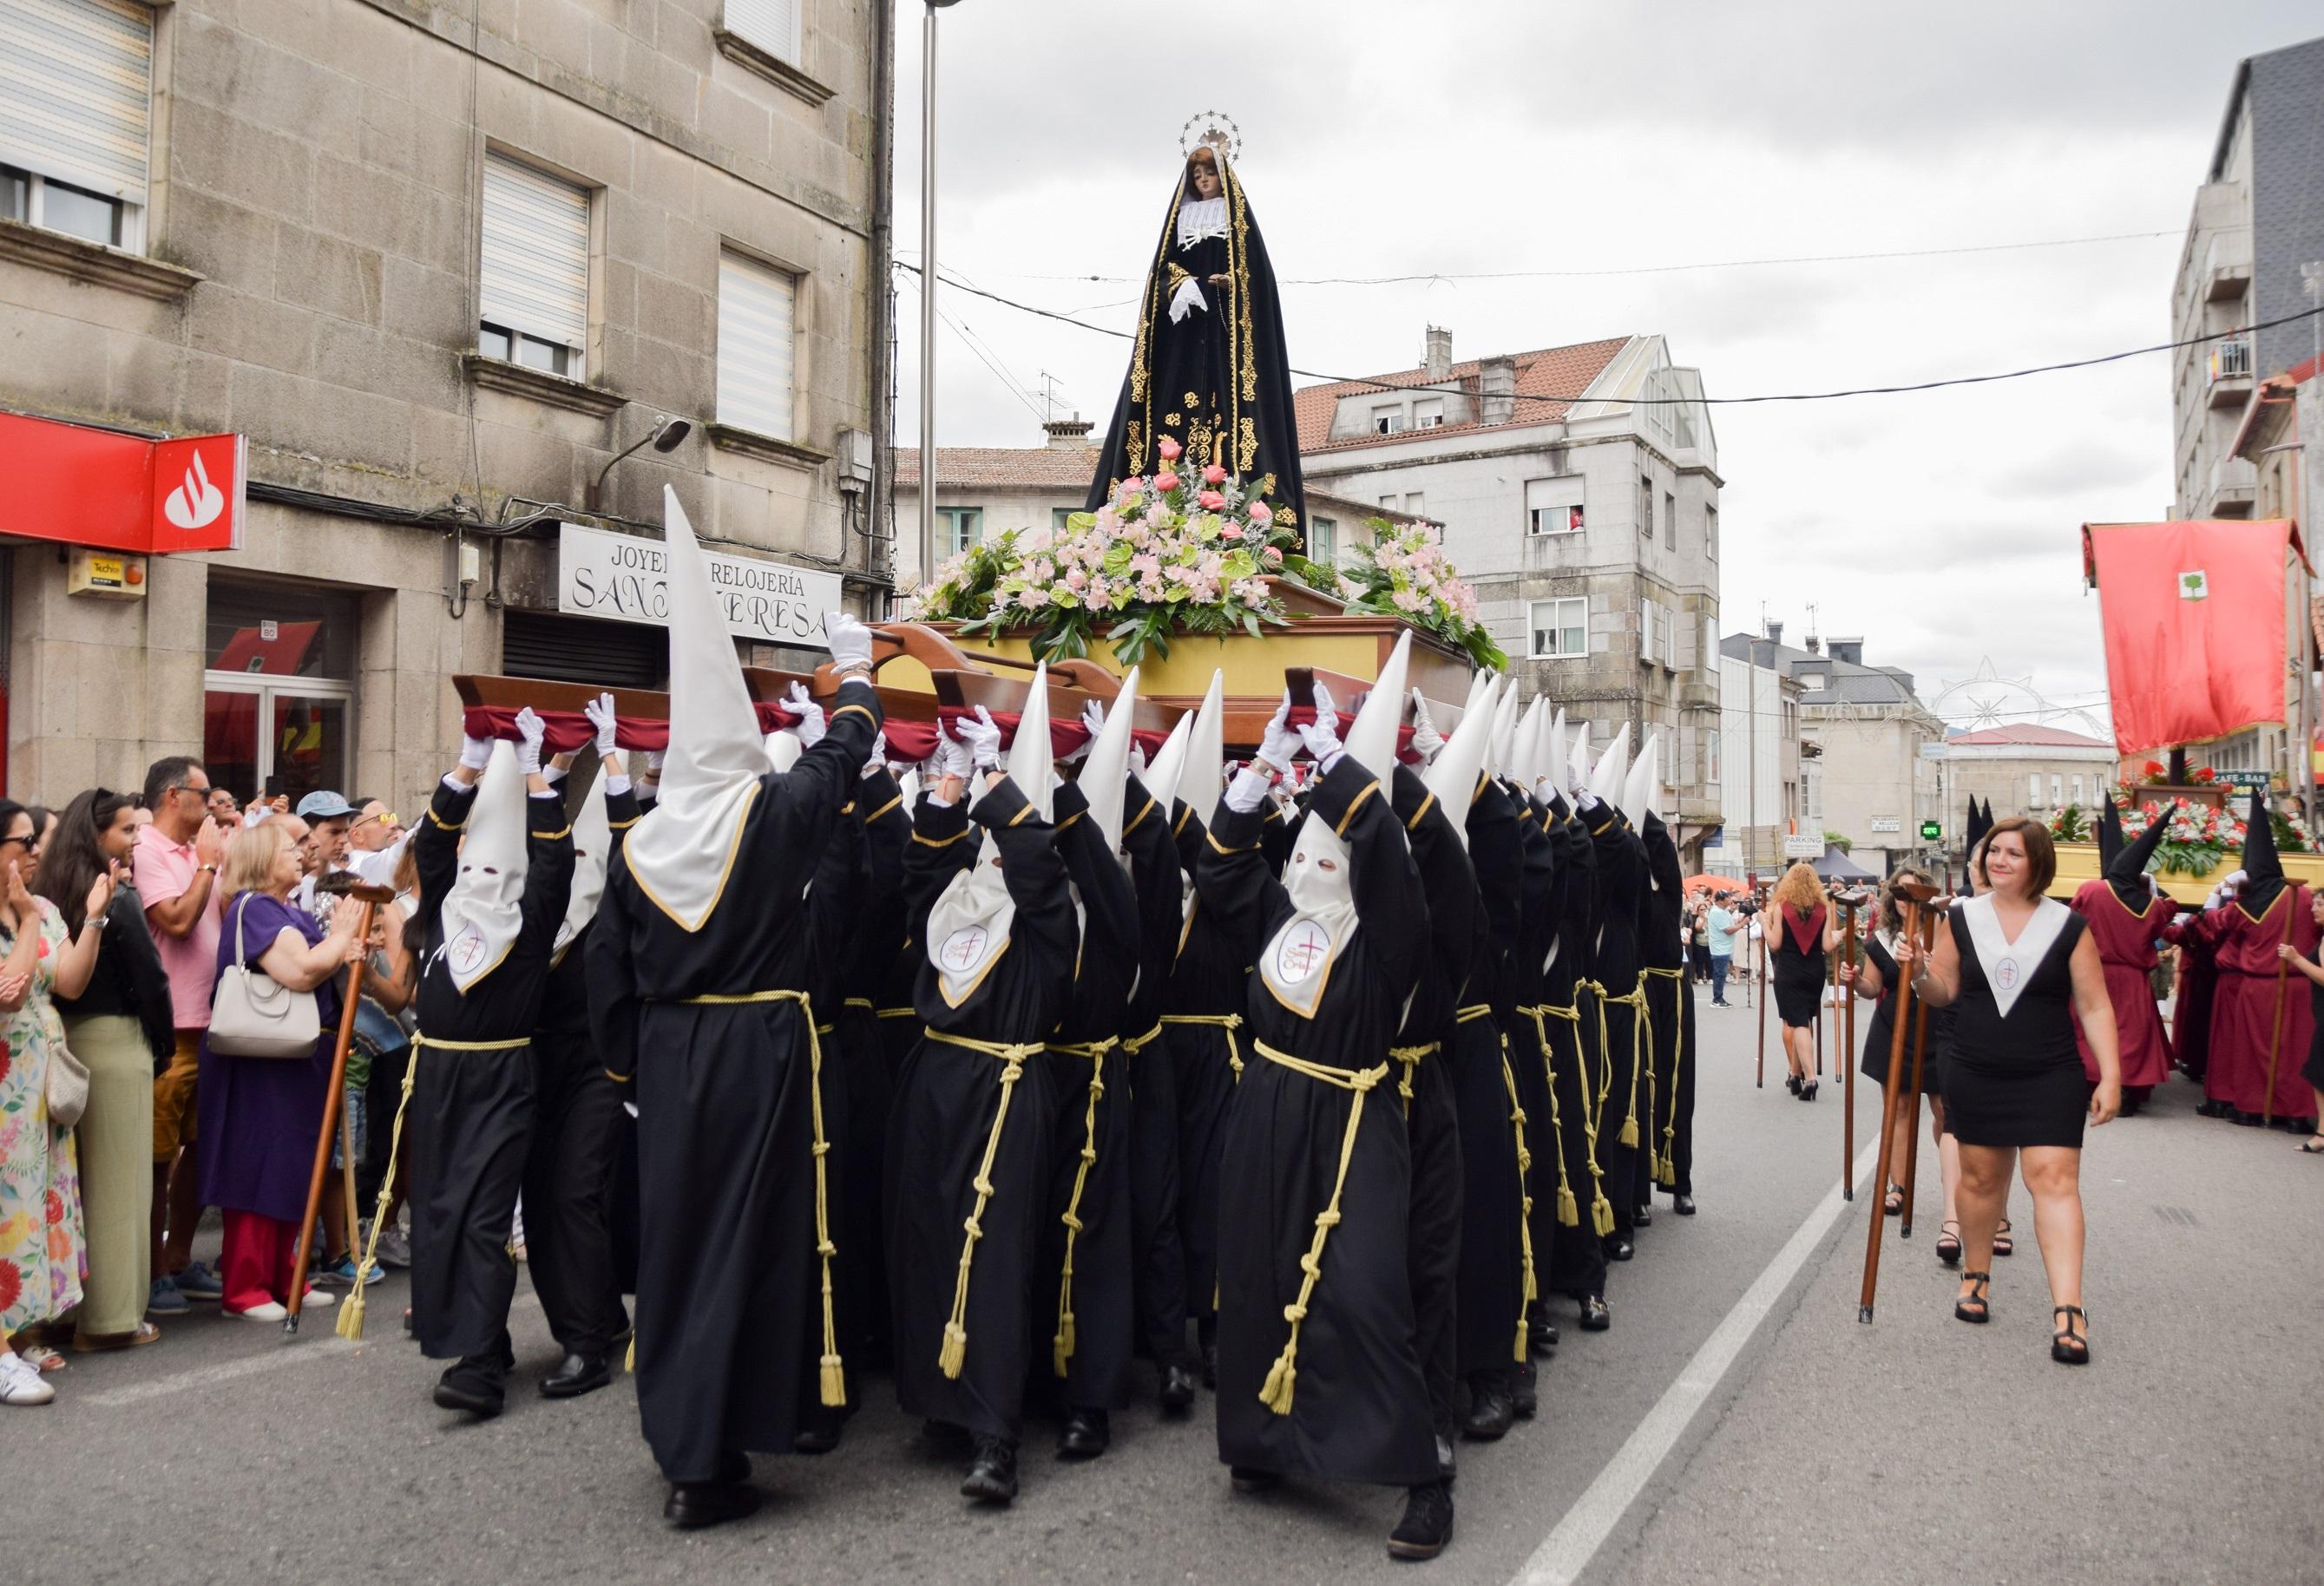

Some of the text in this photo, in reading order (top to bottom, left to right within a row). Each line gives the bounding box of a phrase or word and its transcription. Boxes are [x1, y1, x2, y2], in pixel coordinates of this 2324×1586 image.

[710, 562, 805, 597] RELOJERÍA
[572, 567, 829, 640] SAN ERESA
[1283, 959, 1316, 972] Cristo
[1284, 947, 1318, 960] Santo
